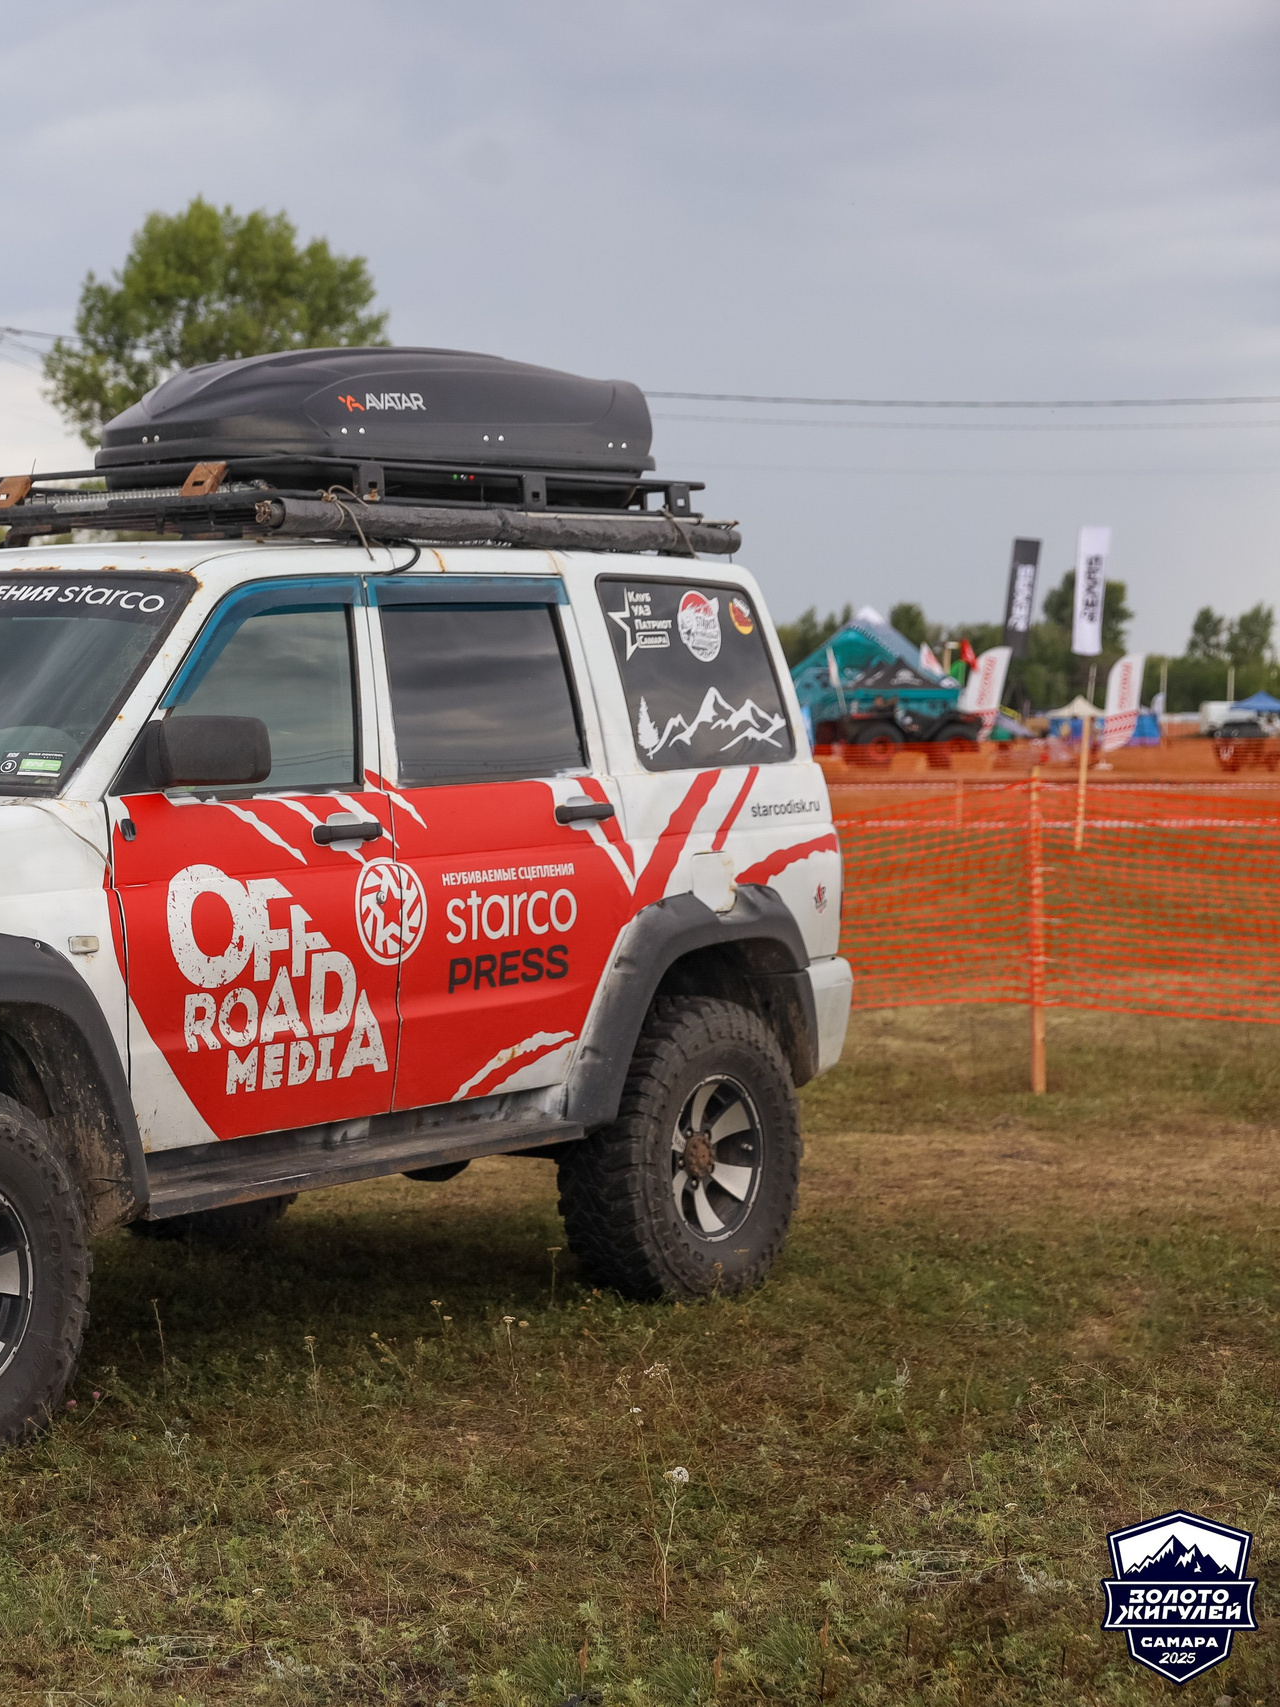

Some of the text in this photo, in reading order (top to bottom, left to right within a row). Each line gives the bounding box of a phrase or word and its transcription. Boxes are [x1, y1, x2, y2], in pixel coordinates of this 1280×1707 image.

[365, 392, 427, 411] AVATAR
[57, 584, 166, 613] starco
[631, 604, 652, 617] УАЗ
[4, 762, 13, 770] 3
[751, 799, 821, 818] starcodisk.ru
[441, 862, 575, 886] НЕУБИВАЕМЫЕ СЦЕПЛЕНИЯ
[166, 863, 332, 988] OFF
[445, 888, 578, 944] starco
[448, 944, 569, 994] PRESS
[183, 950, 357, 1053] ROAD
[225, 988, 389, 1095] MEDIA
